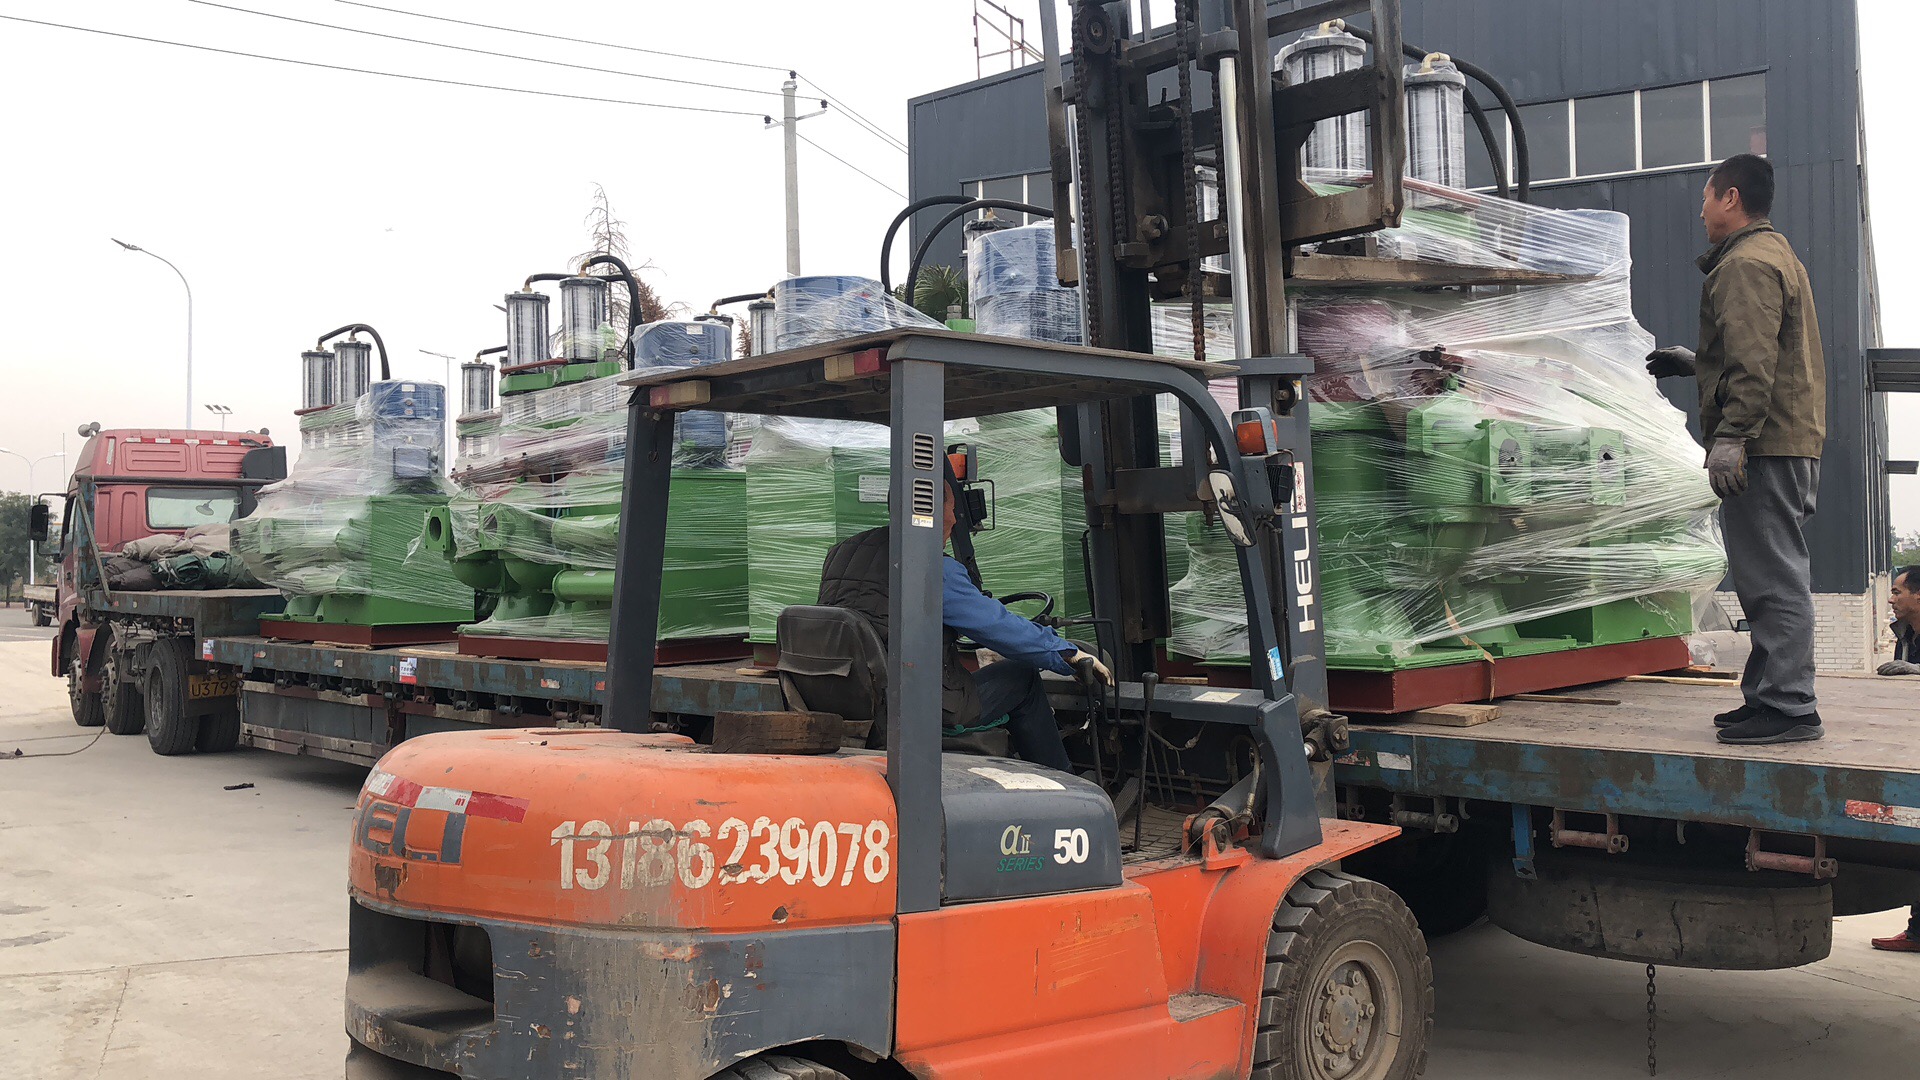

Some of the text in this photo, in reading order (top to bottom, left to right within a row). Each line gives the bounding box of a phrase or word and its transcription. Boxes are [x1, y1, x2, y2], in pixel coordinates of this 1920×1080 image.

[1291, 516, 1316, 633] HELI
[550, 816, 890, 890] 13186239078
[997, 856, 1045, 873] SERIES
[1053, 828, 1090, 864] 50
